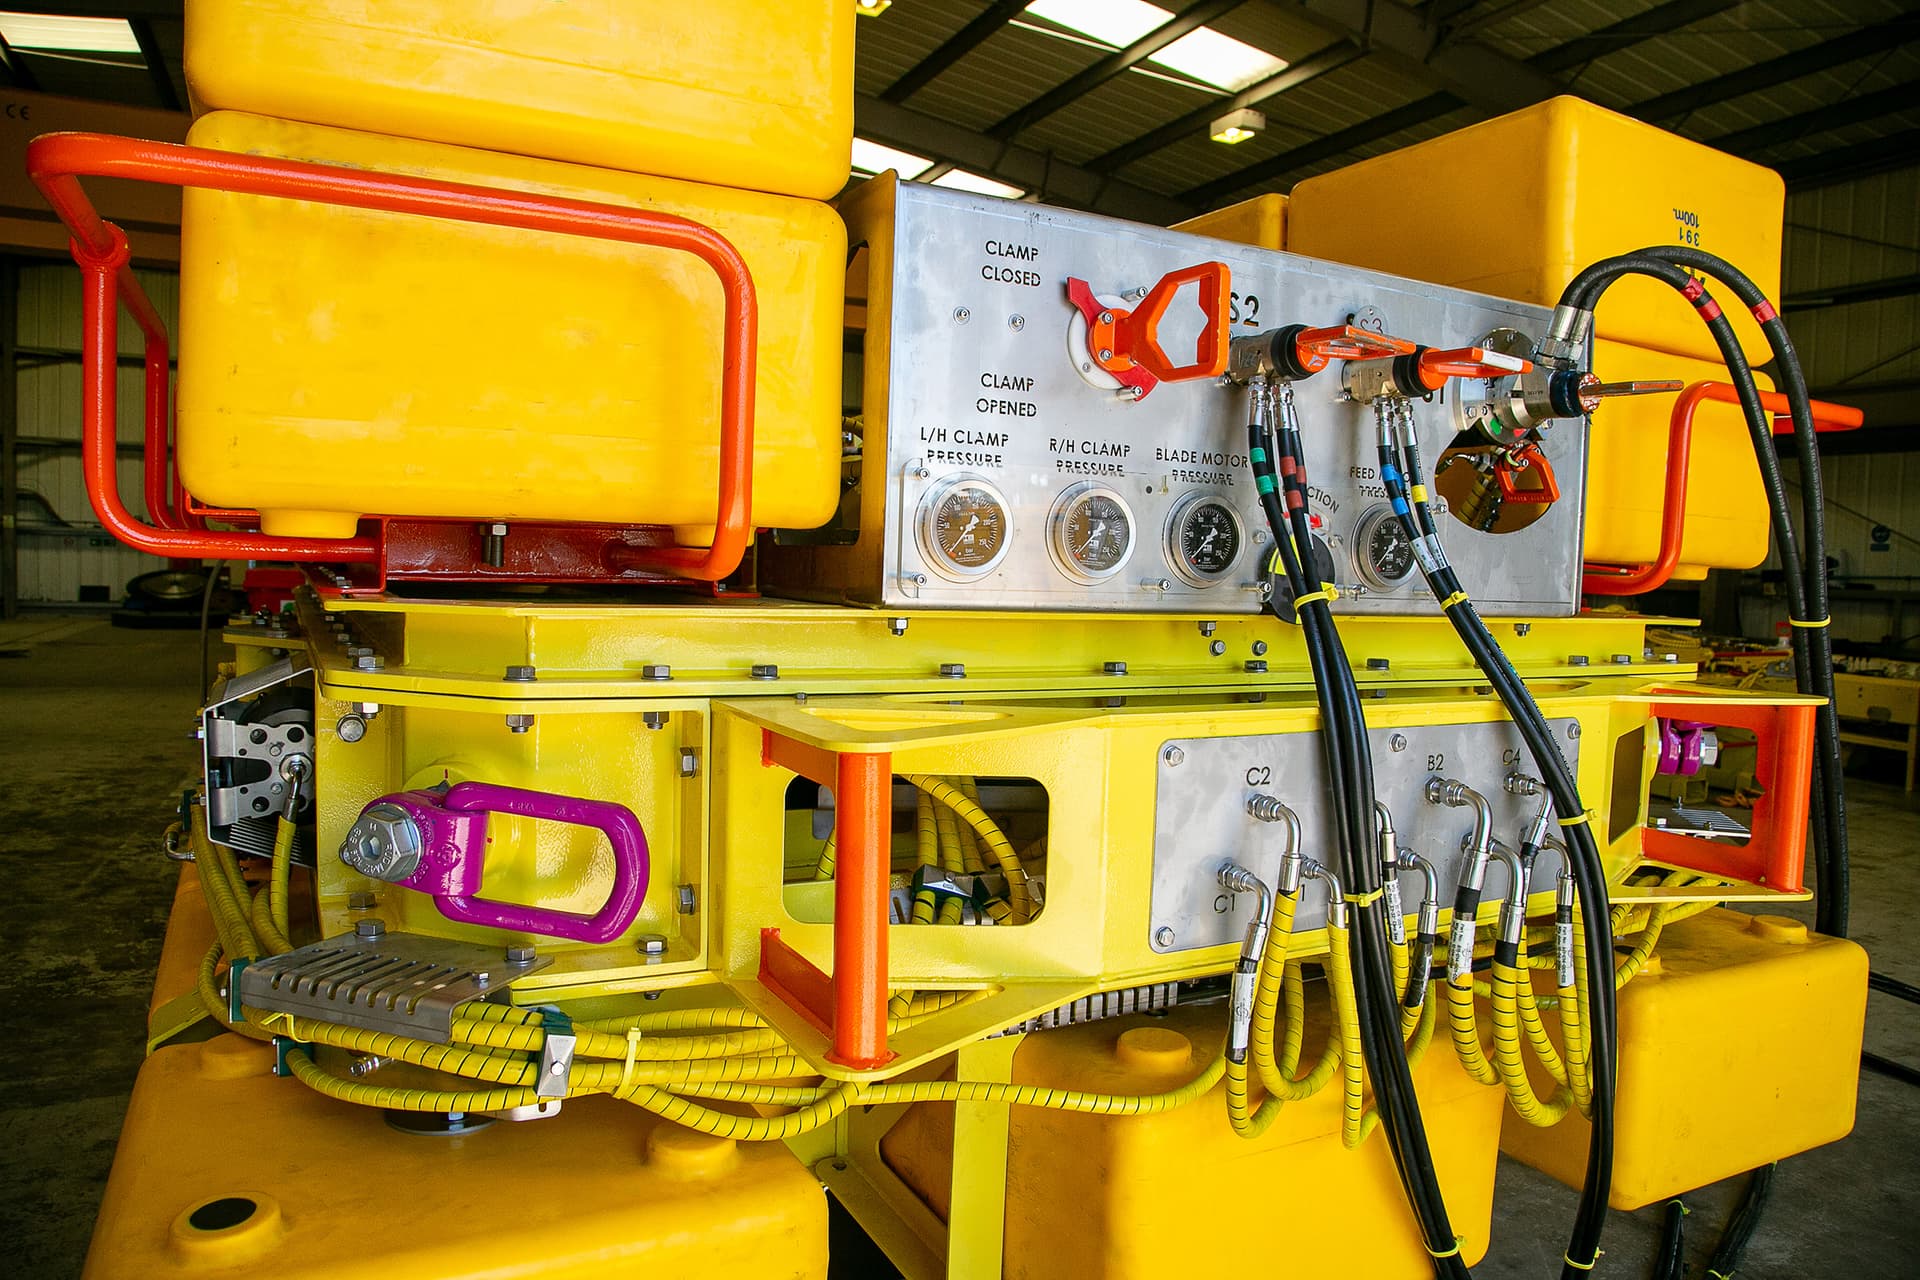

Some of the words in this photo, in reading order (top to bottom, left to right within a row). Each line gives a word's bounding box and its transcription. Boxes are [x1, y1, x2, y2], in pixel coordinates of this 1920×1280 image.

[985, 240, 1039, 262] CLAMP
[981, 265, 1041, 287] CLOSED
[1230, 291, 1260, 327] S2
[981, 372, 1034, 392] CLAMP
[976, 398, 1037, 417] OPENED
[920, 426, 947, 444] L/H
[953, 429, 1009, 447] CLAMP
[1049, 438, 1075, 454] R/H
[1081, 440, 1131, 458] CLAMP
[1156, 447, 1197, 464] BLADE
[1201, 451, 1248, 469] MOTOR
[927, 449, 1004, 468] PRESSURE
[1056, 459, 1125, 478] PRESSURE
[1172, 469, 1235, 486] PRESSURE
[1350, 466, 1375, 480] FEED
[1427, 753, 1444, 771] B2
[1502, 747, 1521, 767] C4
[1246, 766, 1271, 786] C2
[1213, 893, 1236, 914] C1
